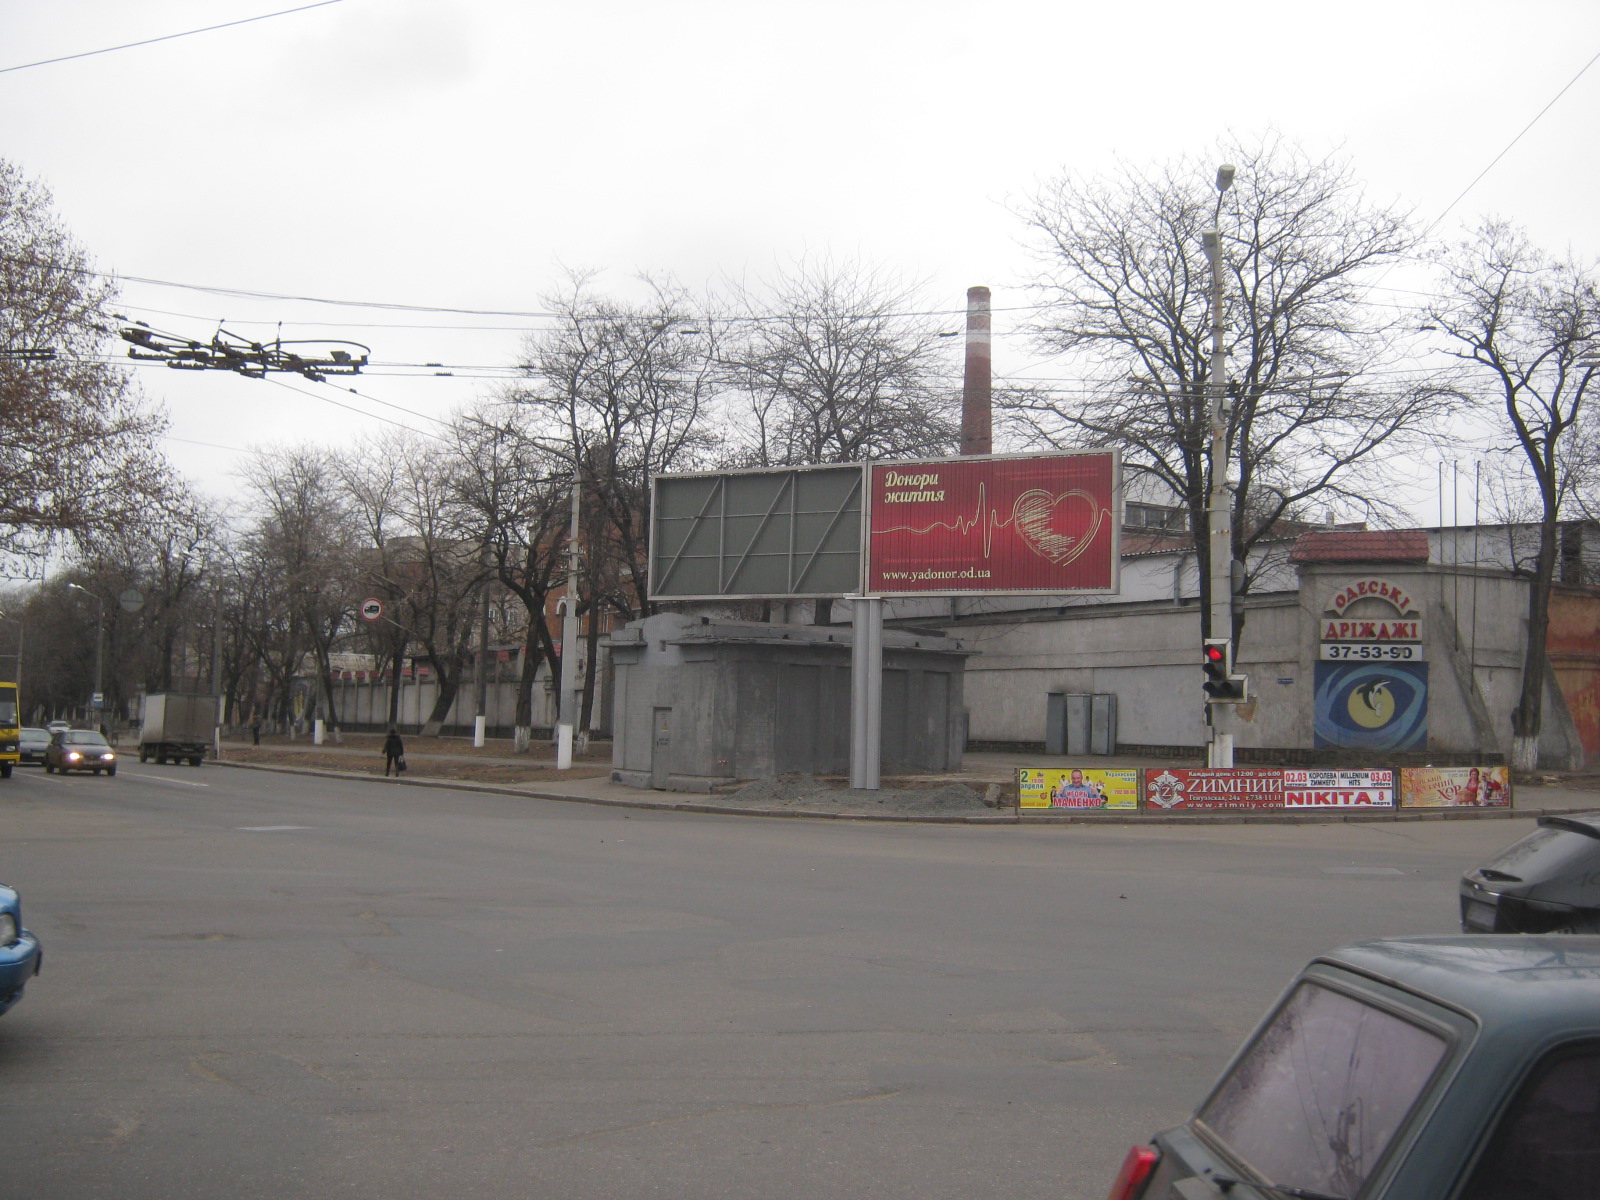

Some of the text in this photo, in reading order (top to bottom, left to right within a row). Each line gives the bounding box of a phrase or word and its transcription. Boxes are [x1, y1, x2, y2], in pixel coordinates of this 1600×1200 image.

[885, 471, 939, 490] Донори
[884, 489, 945, 504] життя
[882, 567, 991, 583] www.yadonor.od.ua
[1335, 581, 1410, 609] ОДЕСЬКІ
[1325, 622, 1418, 640] ДРІЖДЖІ
[1329, 646, 1413, 659] 37-53-90
[1020, 770, 1029, 783] 2
[1285, 772, 1307, 782] 02.03
[1370, 772, 1391, 782] 03.03
[1286, 792, 1372, 805] NIKITA
[1378, 791, 1384, 800] 8
[1053, 798, 1102, 807] МАМЕНКО
